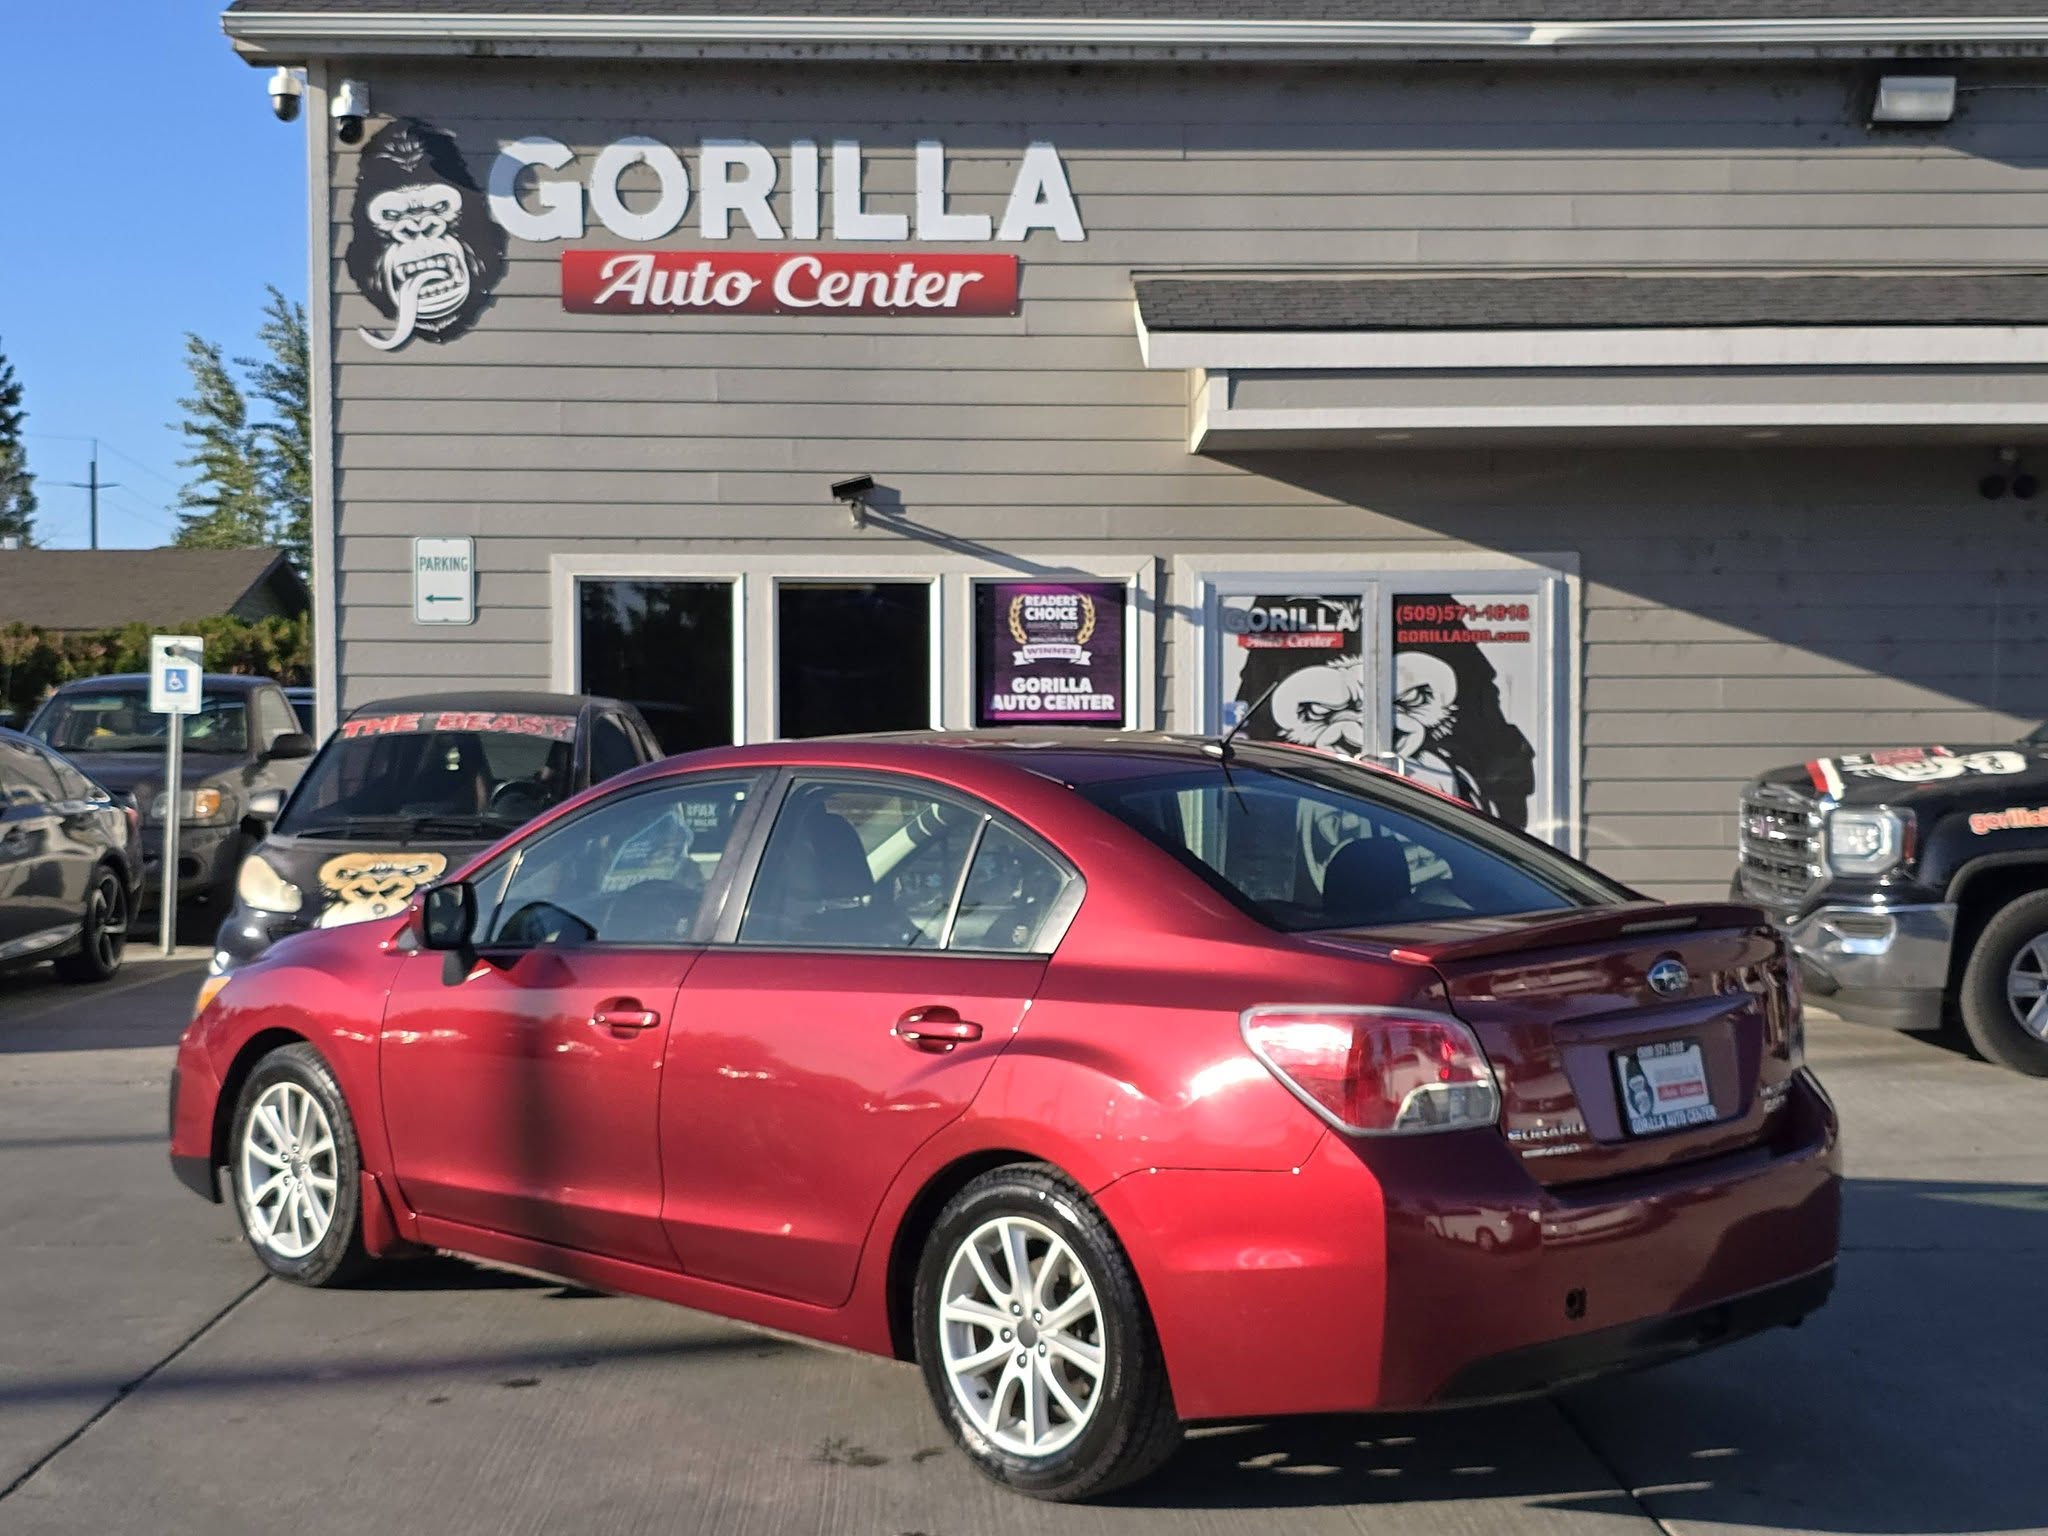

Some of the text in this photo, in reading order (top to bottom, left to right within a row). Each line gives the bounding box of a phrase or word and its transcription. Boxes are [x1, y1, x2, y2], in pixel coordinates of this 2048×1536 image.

[489, 136, 1086, 241] GORILLA
[594, 254, 984, 309] Auto Center
[419, 556, 469, 572] PARKING
[1024, 594, 1078, 606] READERS
[1024, 607, 1078, 621] CHOICE
[1224, 606, 1359, 632] GORILLA
[1026, 647, 1077, 656] WINNER
[1011, 677, 1093, 694] GORILLA
[991, 694, 1115, 711] AUTO CENTER
[342, 711, 575, 738] THE BEAST
